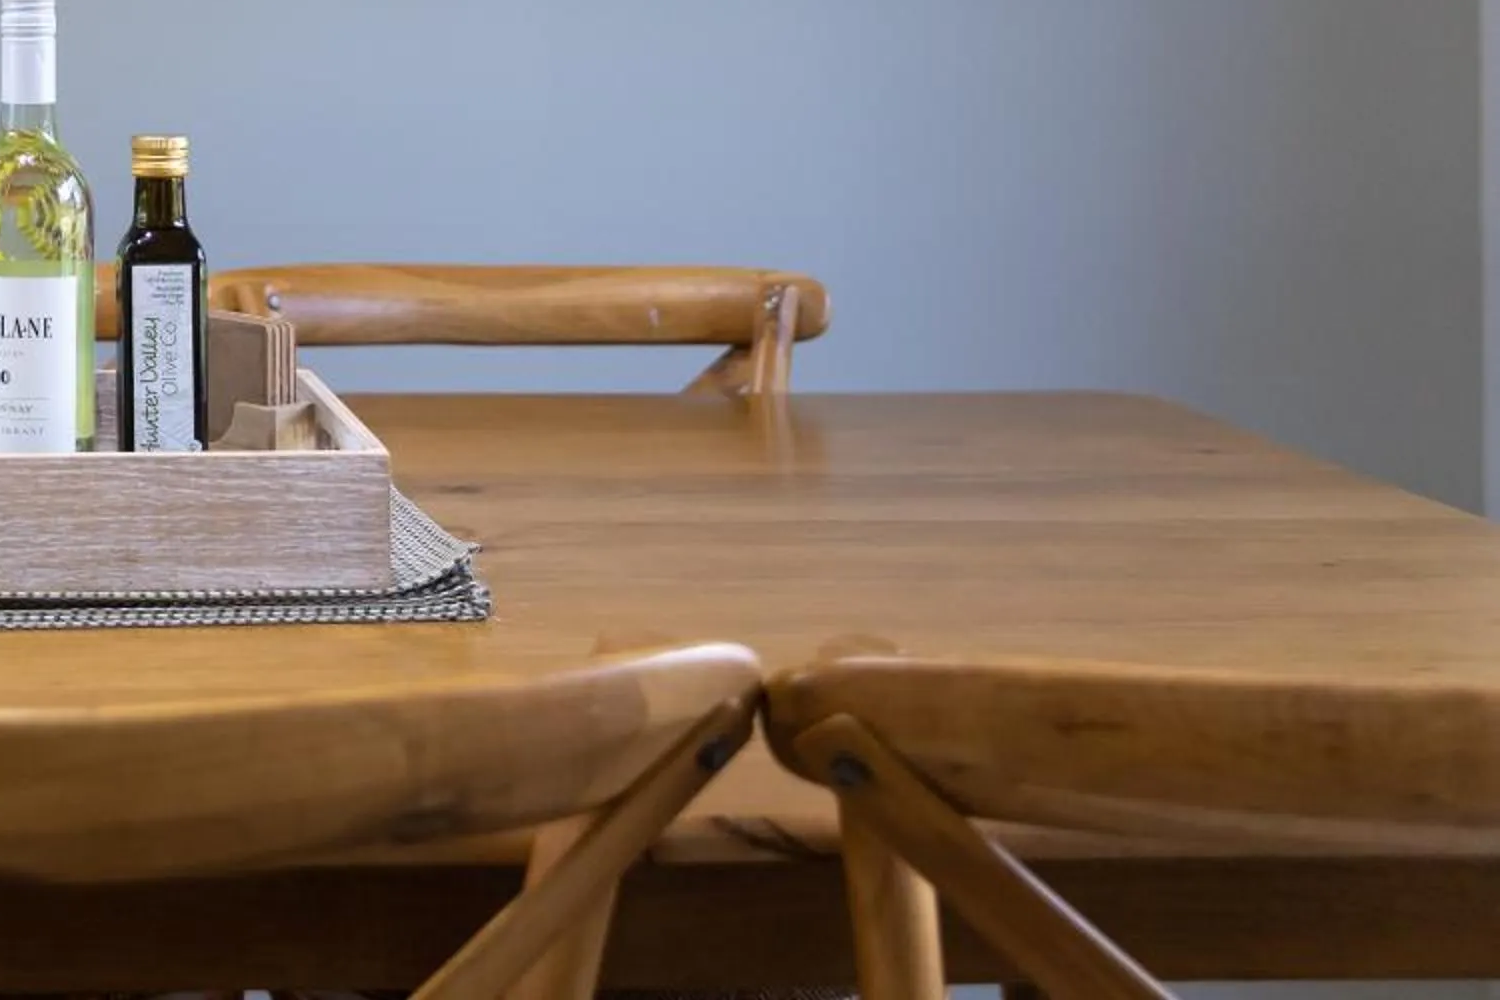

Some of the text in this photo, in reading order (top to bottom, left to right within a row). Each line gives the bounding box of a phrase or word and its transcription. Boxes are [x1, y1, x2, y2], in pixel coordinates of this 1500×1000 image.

[0, 314, 54, 339] LANE
[160, 320, 179, 348] Co
[137, 316, 160, 383] Valley
[161, 351, 180, 397] Olive
